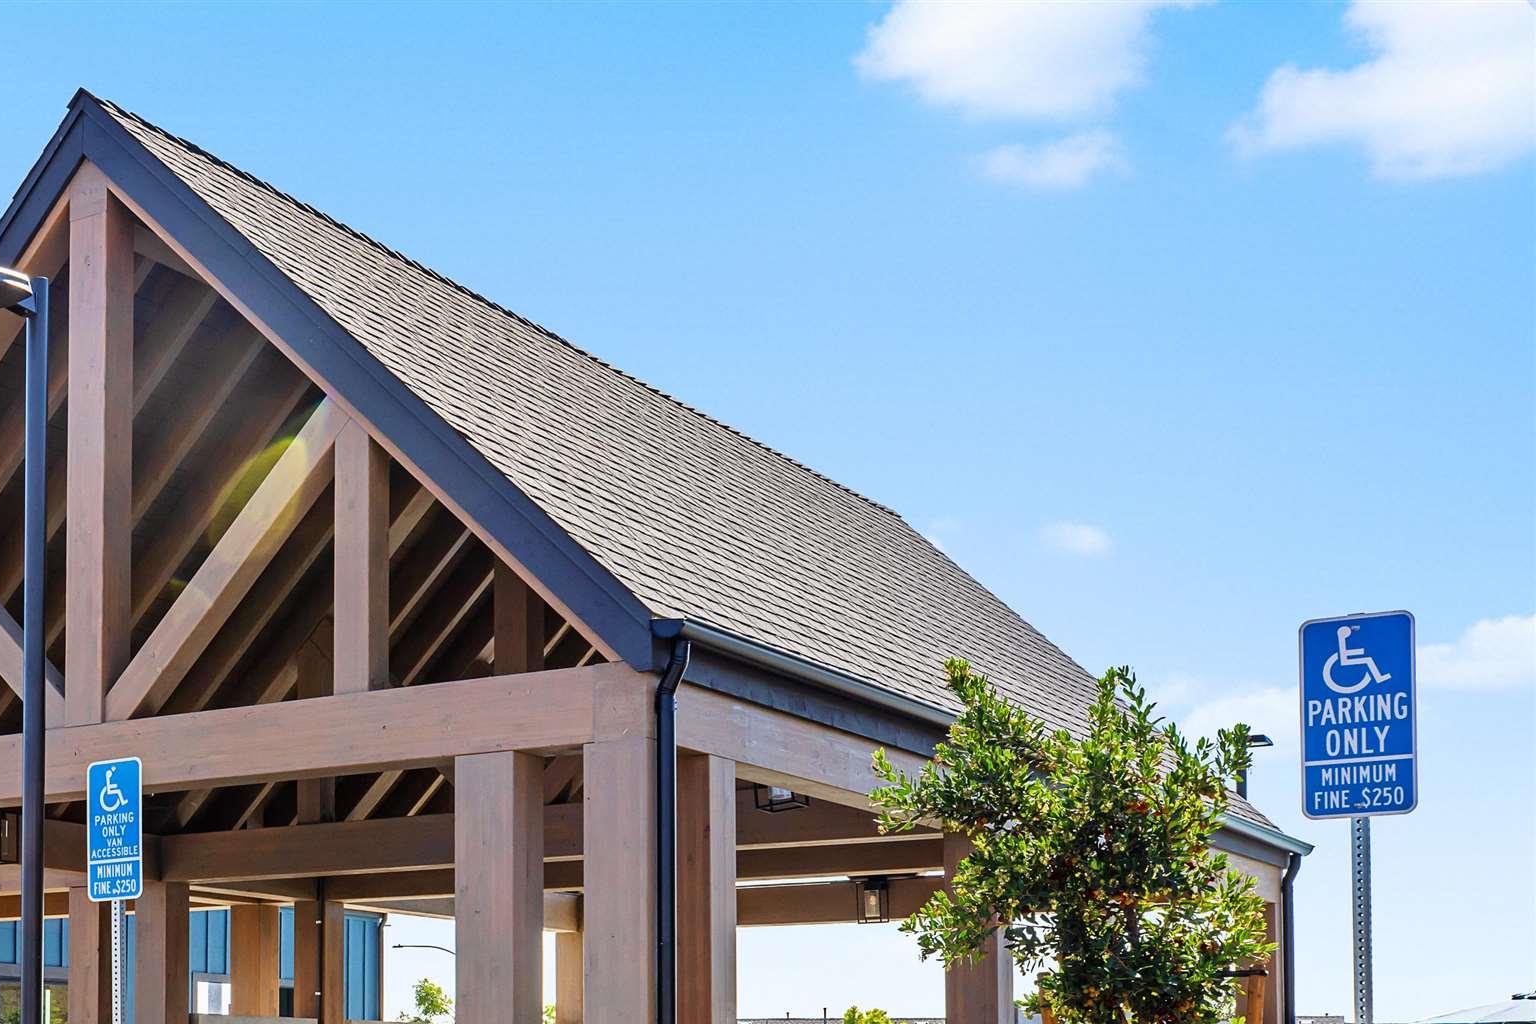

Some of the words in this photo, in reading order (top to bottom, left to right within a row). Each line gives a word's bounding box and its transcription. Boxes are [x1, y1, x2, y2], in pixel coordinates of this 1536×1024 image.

[1308, 692, 1408, 727] PARKING
[1325, 725, 1390, 757] ONLY
[1321, 763, 1397, 786] MINIMUM
[1314, 790, 1350, 810] FINE
[1361, 786, 1404, 809] $250
[94, 812, 134, 826] PARKING
[102, 825, 126, 838] ONLY
[106, 837, 123, 847] VAN
[91, 845, 138, 859] ACCESSIBLE
[97, 863, 133, 879] MINIMUM
[93, 881, 111, 895] FINE
[116, 879, 137, 895] $250
